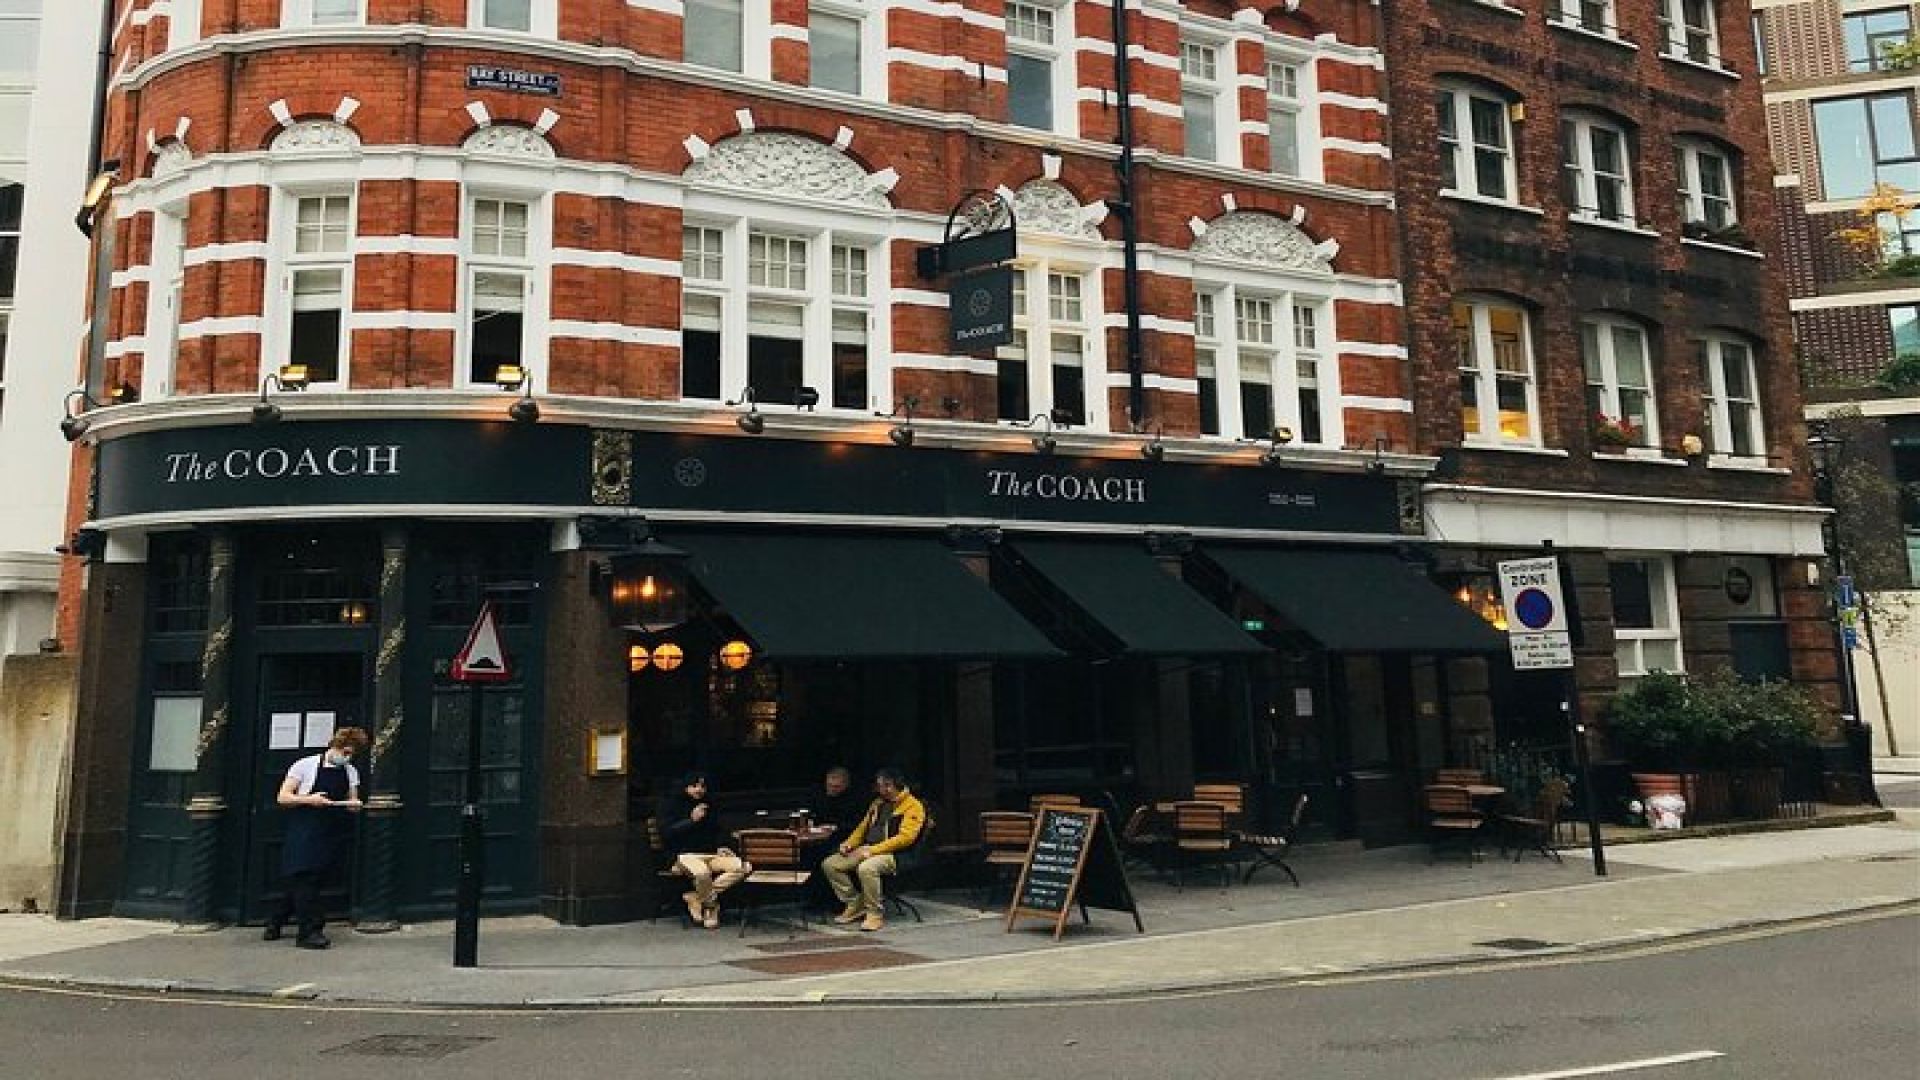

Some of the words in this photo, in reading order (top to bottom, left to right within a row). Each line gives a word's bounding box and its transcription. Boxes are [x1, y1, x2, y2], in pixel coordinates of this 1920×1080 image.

[166, 451, 218, 482] The
[223, 445, 401, 478] COACH
[987, 470, 1033, 496] The
[1036, 473, 1145, 502] COACH
[1511, 574, 1547, 587] ZONE
